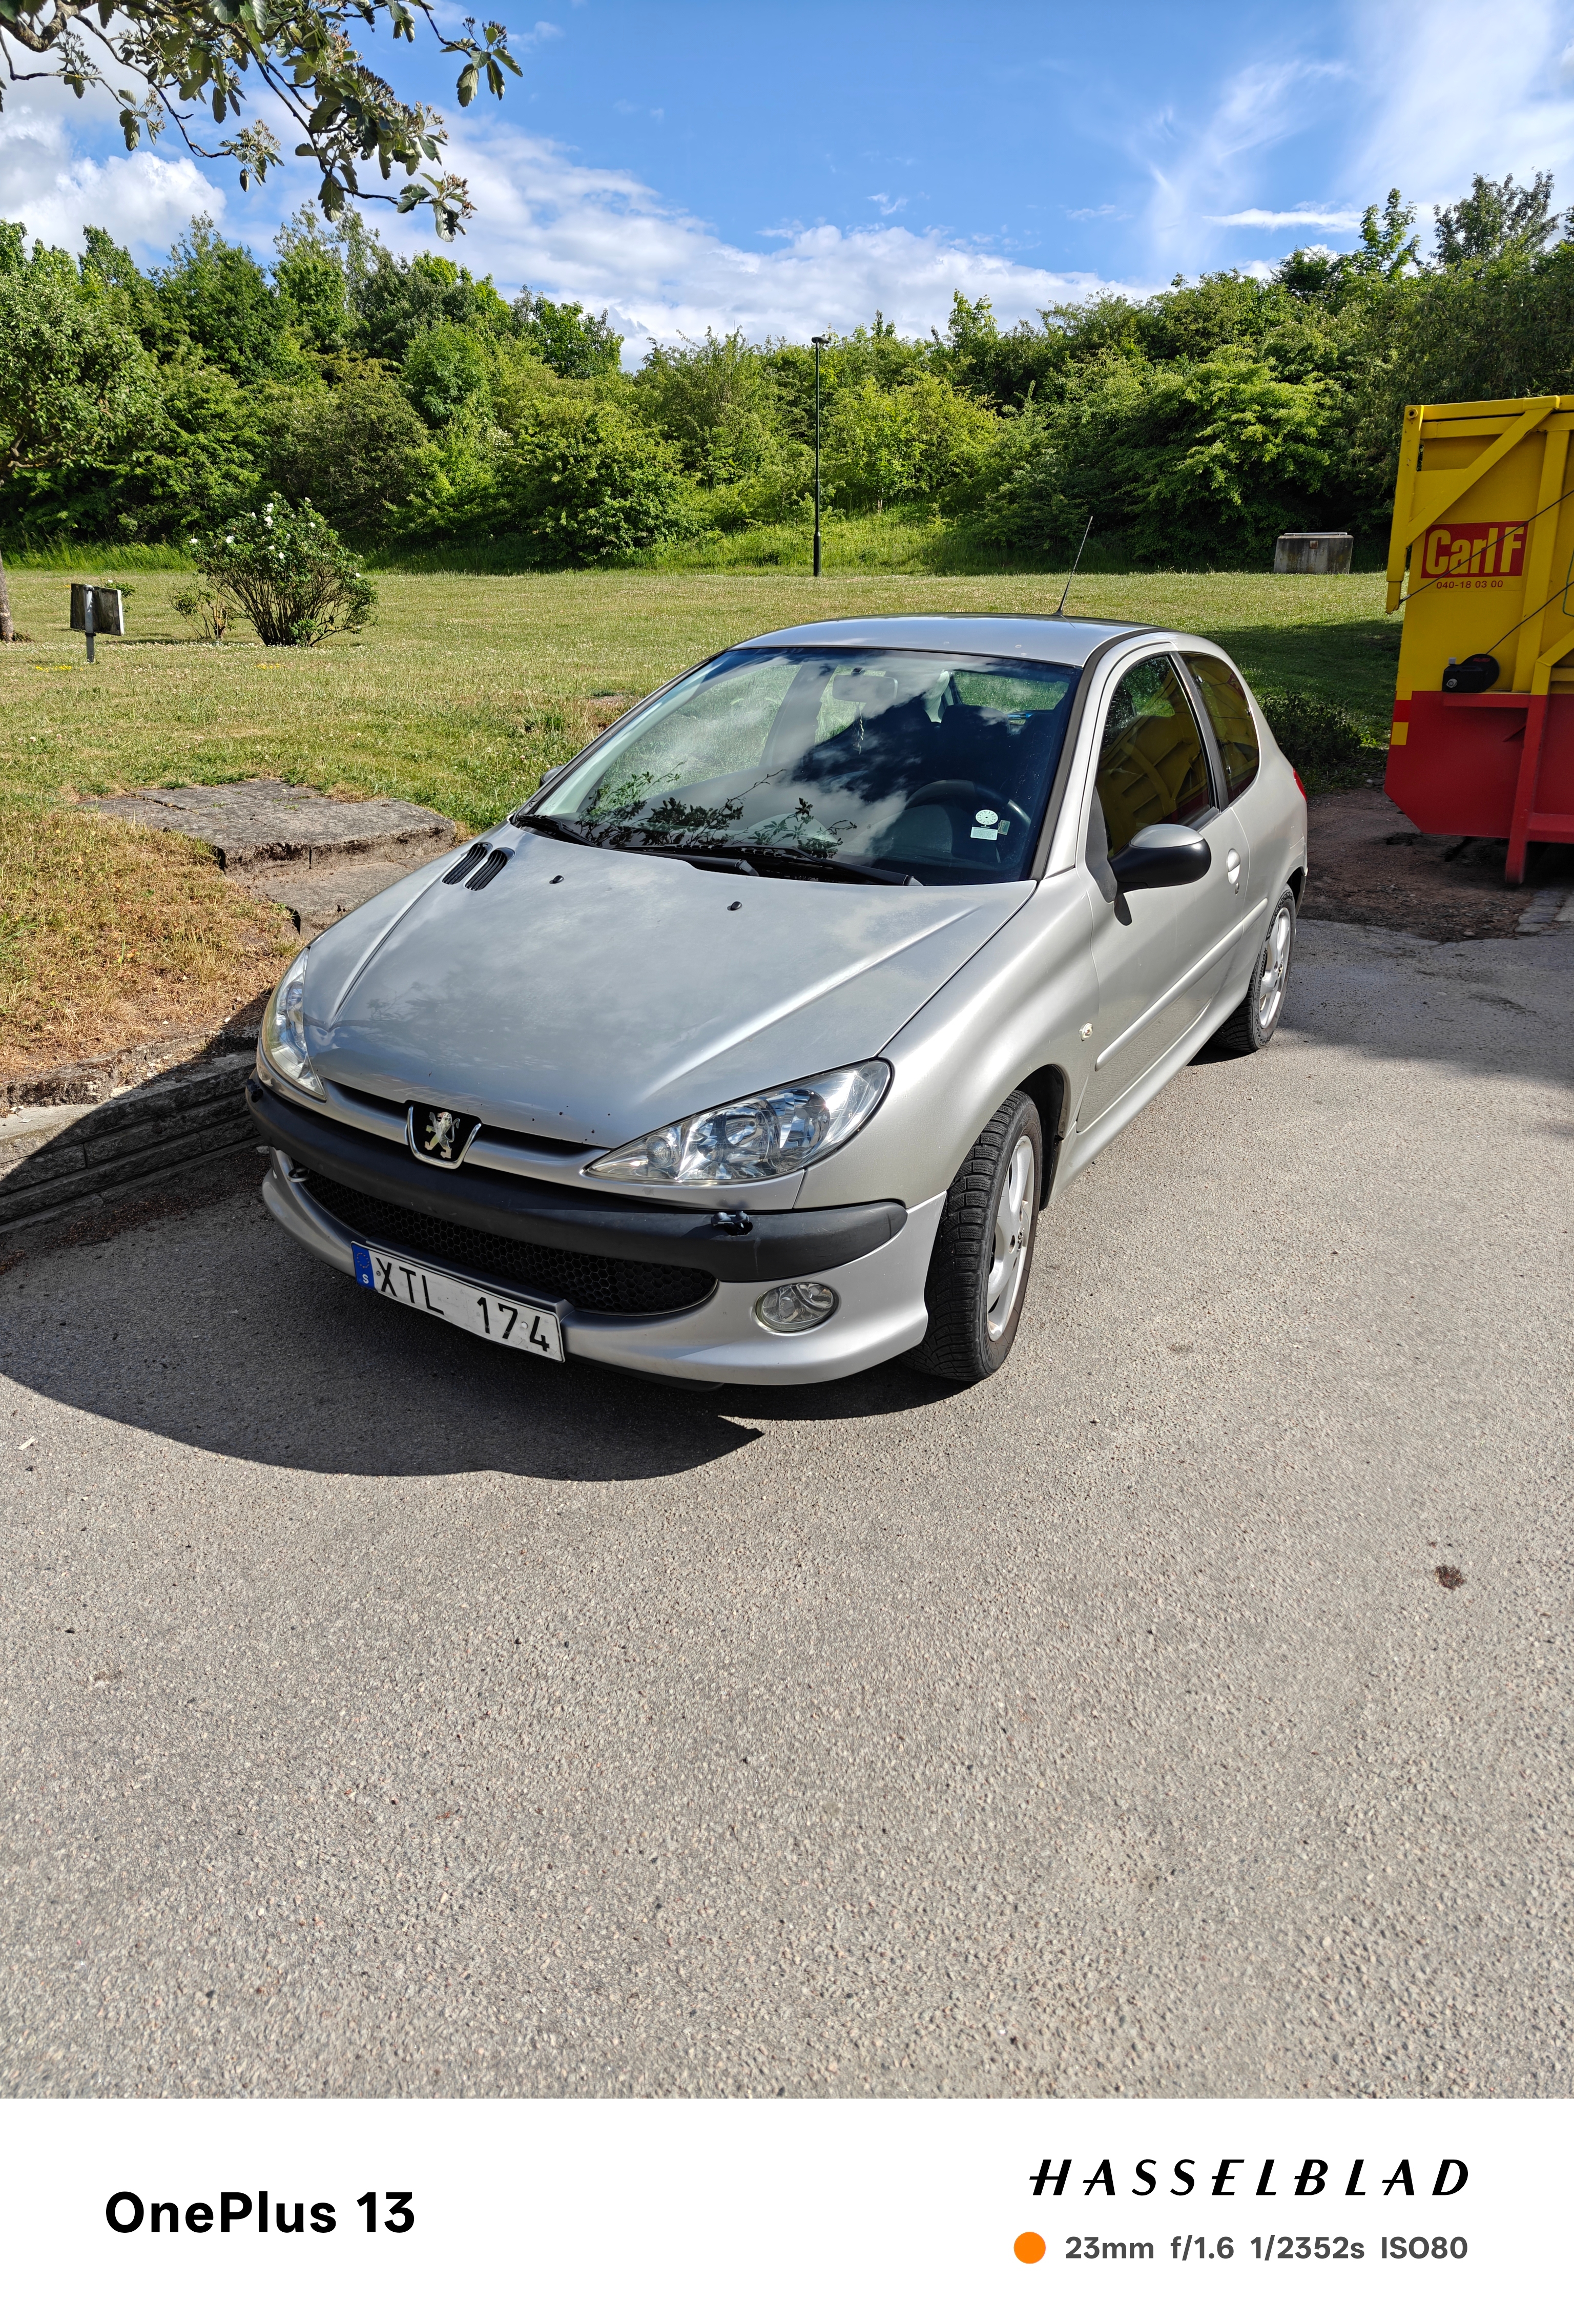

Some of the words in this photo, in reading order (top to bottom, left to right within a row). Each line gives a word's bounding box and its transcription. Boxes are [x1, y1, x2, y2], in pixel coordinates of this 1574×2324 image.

[1425, 527, 1499, 575] Carl
[1500, 527, 1524, 573] F
[1436, 581, 1472, 589] 040-18
[362, 1274, 369, 1284] S
[376, 1257, 444, 1316] XTL
[477, 1297, 550, 1352] 174
